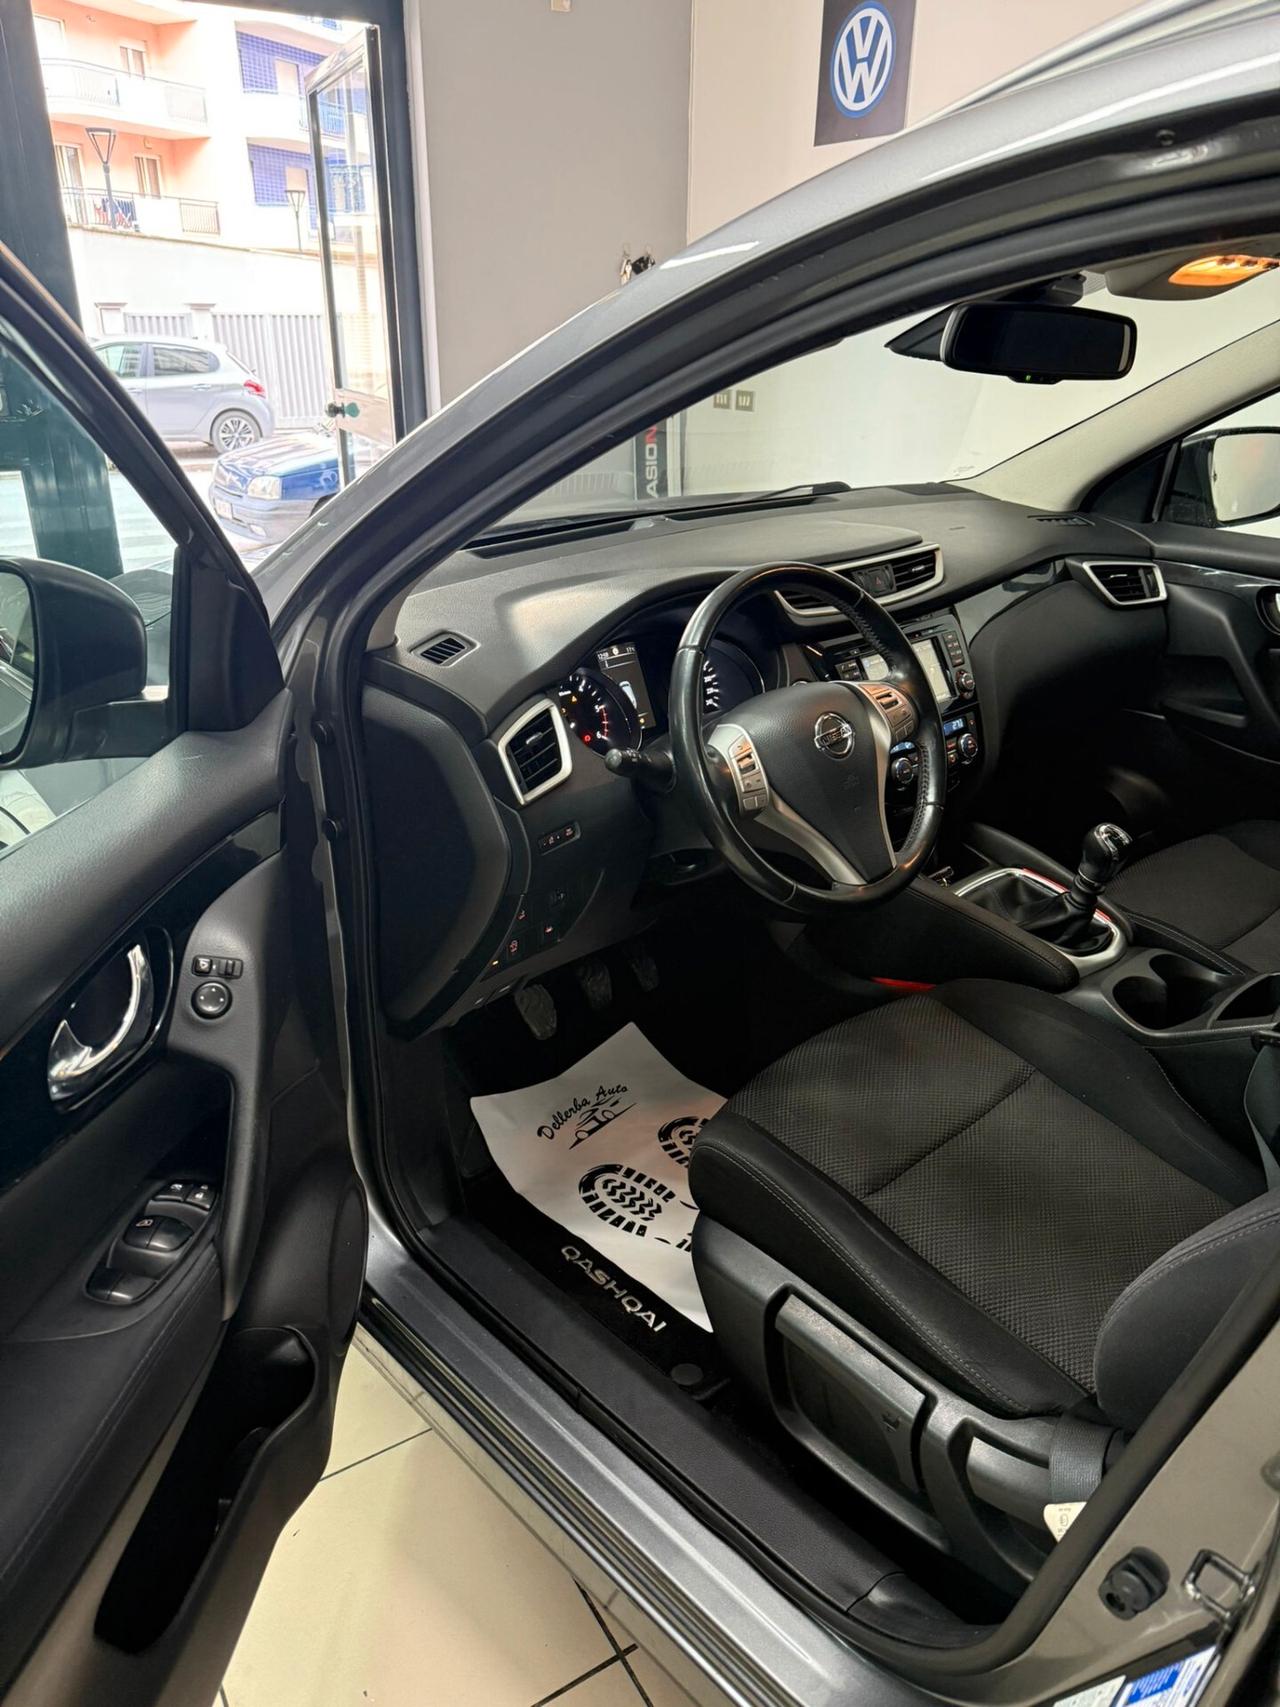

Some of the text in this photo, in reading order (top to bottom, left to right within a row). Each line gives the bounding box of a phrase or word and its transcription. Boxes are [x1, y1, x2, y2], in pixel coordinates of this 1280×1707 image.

[537, 1084, 628, 1140] Dellerba Auto
[561, 1246, 667, 1332] QASHQAI
